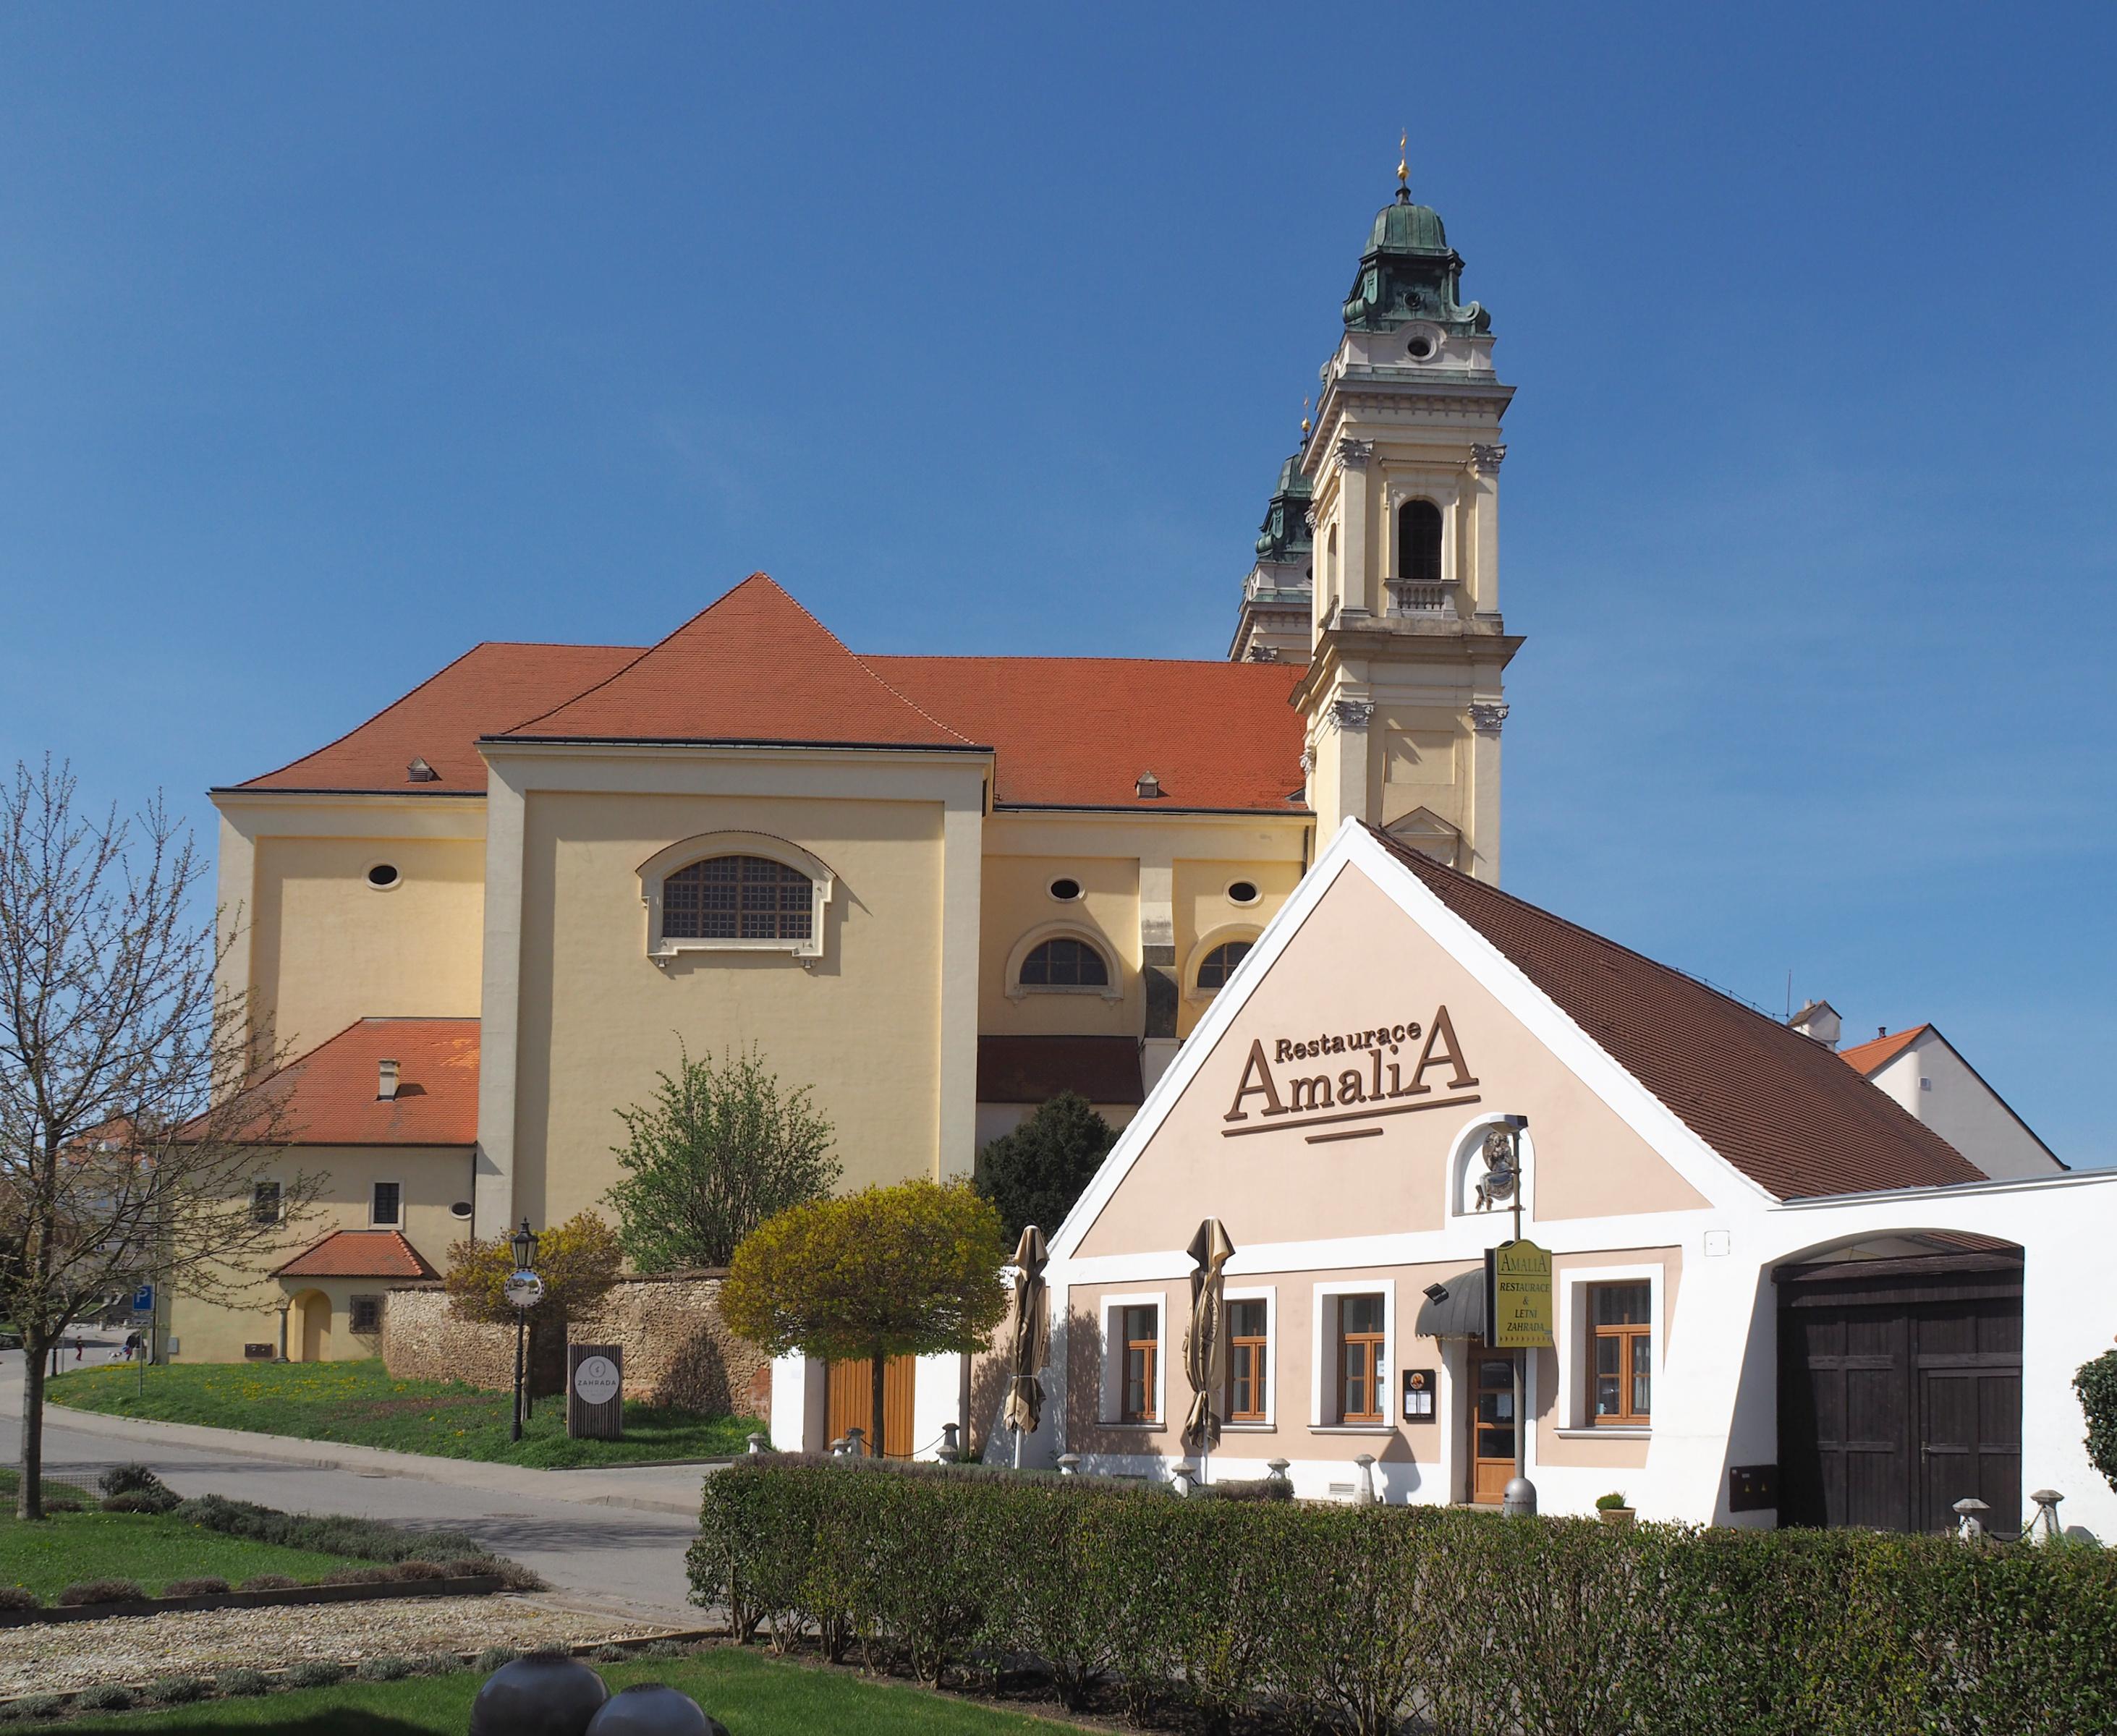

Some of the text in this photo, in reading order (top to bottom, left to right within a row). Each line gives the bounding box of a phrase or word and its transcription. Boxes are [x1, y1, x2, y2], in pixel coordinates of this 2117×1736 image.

[1274, 1021, 1422, 1063] Restaurace
[1223, 1005, 1479, 1122] AmaliA
[1501, 1254, 1548, 1272] AMALIA
[1500, 1282, 1550, 1293] RESTAURACE
[137, 1288, 148, 1303] P
[1522, 1296, 1529, 1305] &
[1507, 1322, 1545, 1332] ZAHRADA
